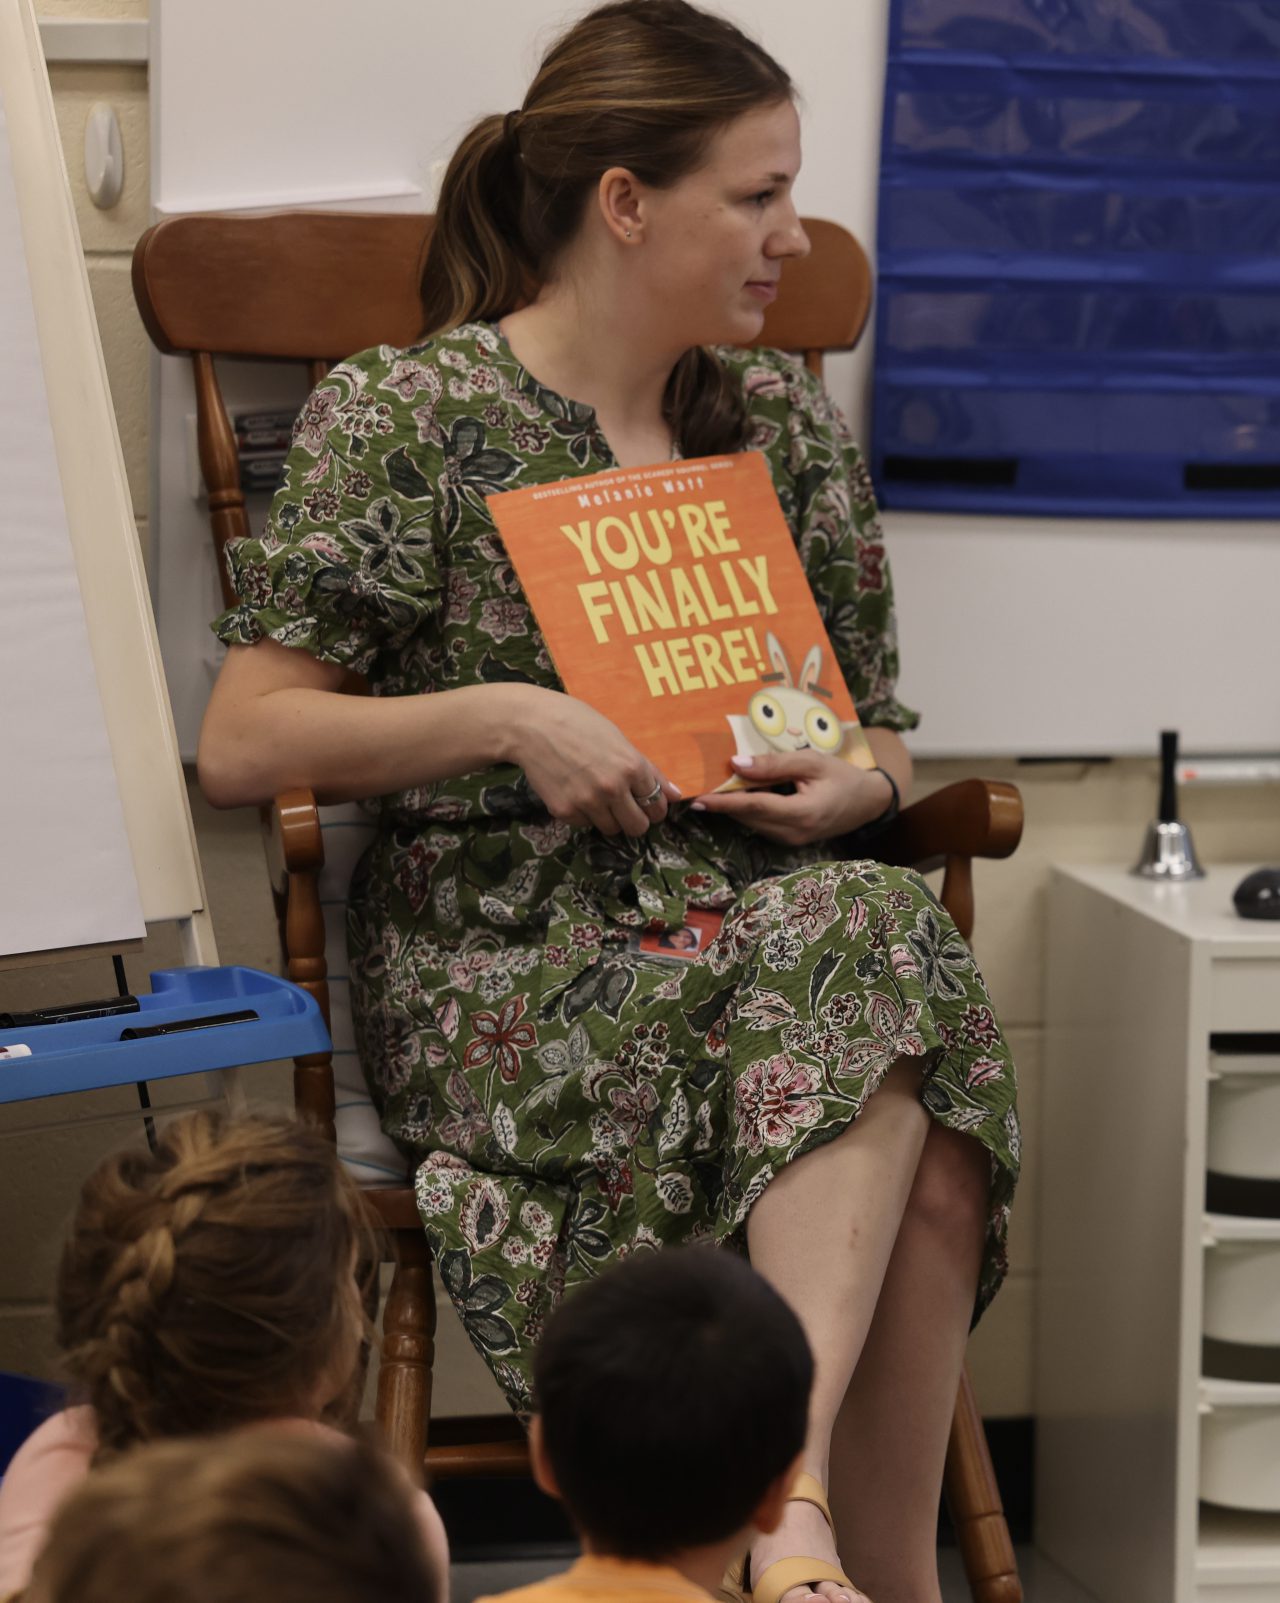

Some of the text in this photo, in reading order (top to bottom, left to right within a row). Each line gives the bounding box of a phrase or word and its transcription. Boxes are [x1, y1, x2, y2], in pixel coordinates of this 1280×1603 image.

[577, 476, 704, 508] Melanie Watt
[577, 556, 779, 645] FINALLY
[633, 627, 766, 698] HERE!
